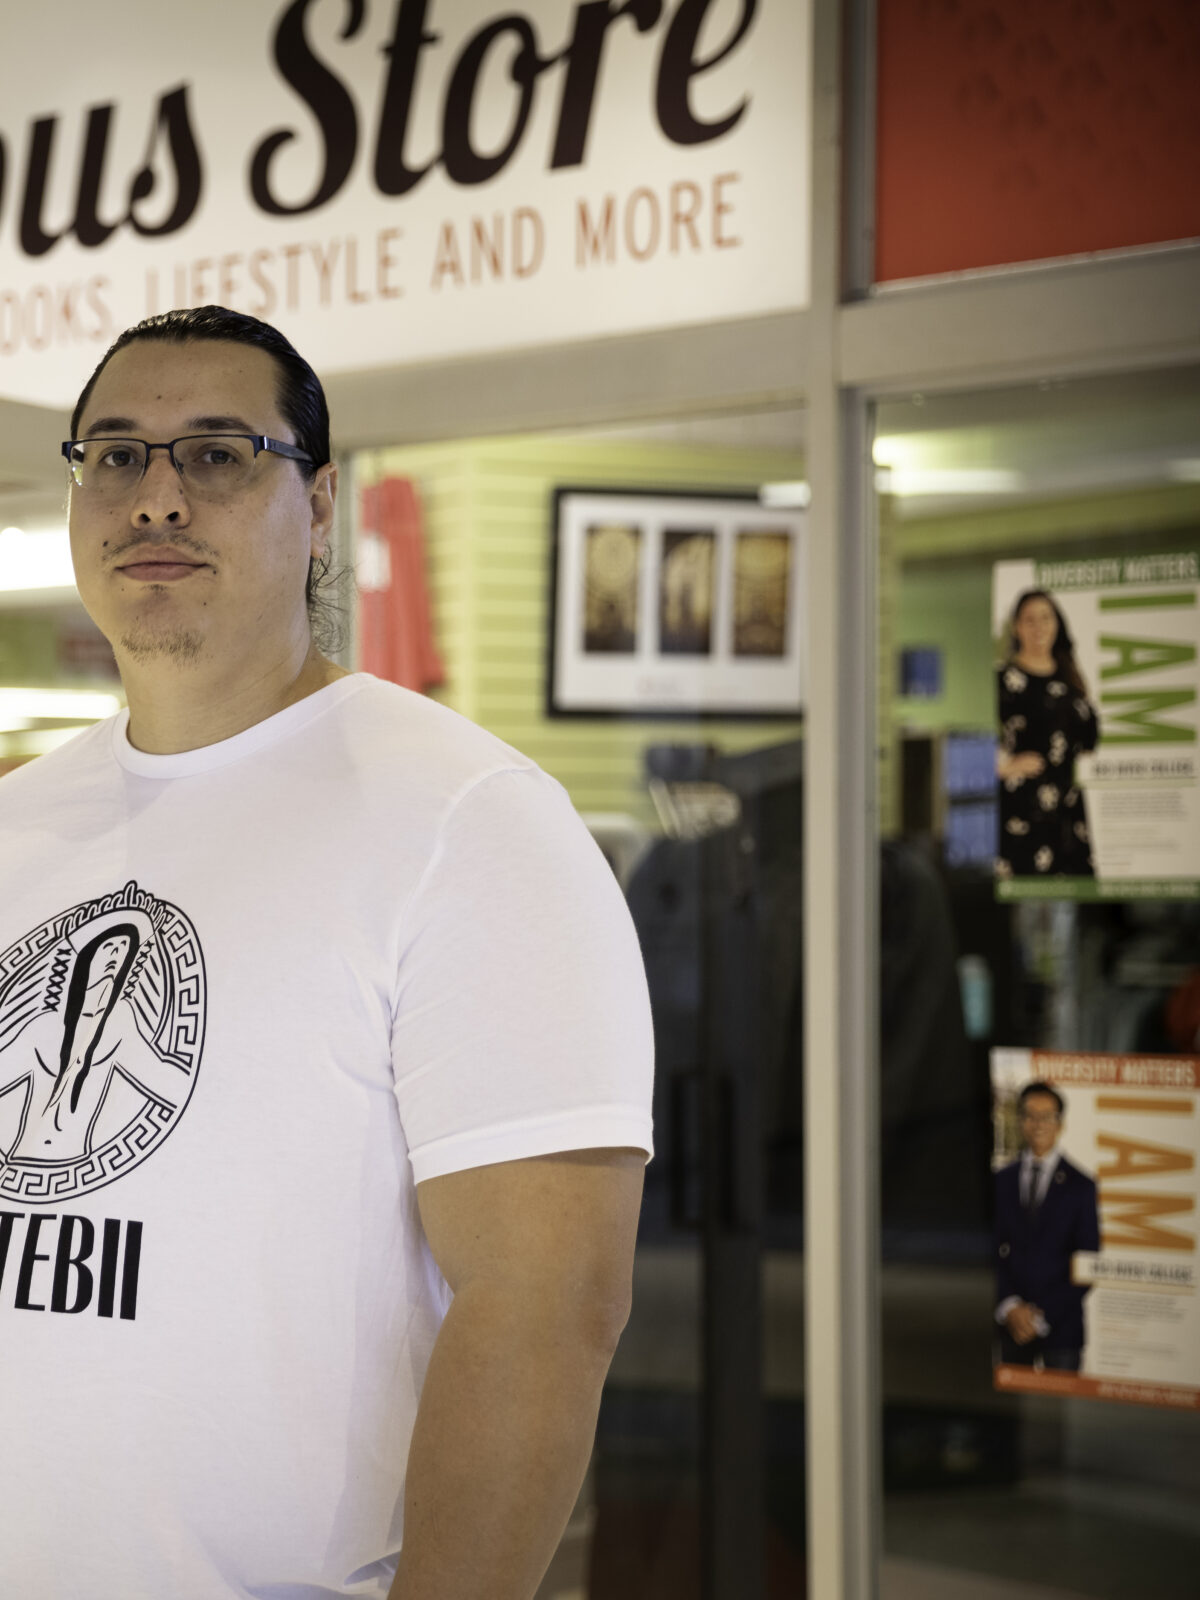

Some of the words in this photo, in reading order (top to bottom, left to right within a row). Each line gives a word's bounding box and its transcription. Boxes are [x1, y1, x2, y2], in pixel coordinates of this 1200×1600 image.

[248, 0, 760, 218] Store
[431, 205, 546, 290] AND
[574, 171, 743, 271] MORE
[1099, 634, 1197, 746] AM
[1095, 1132, 1196, 1253] AM
